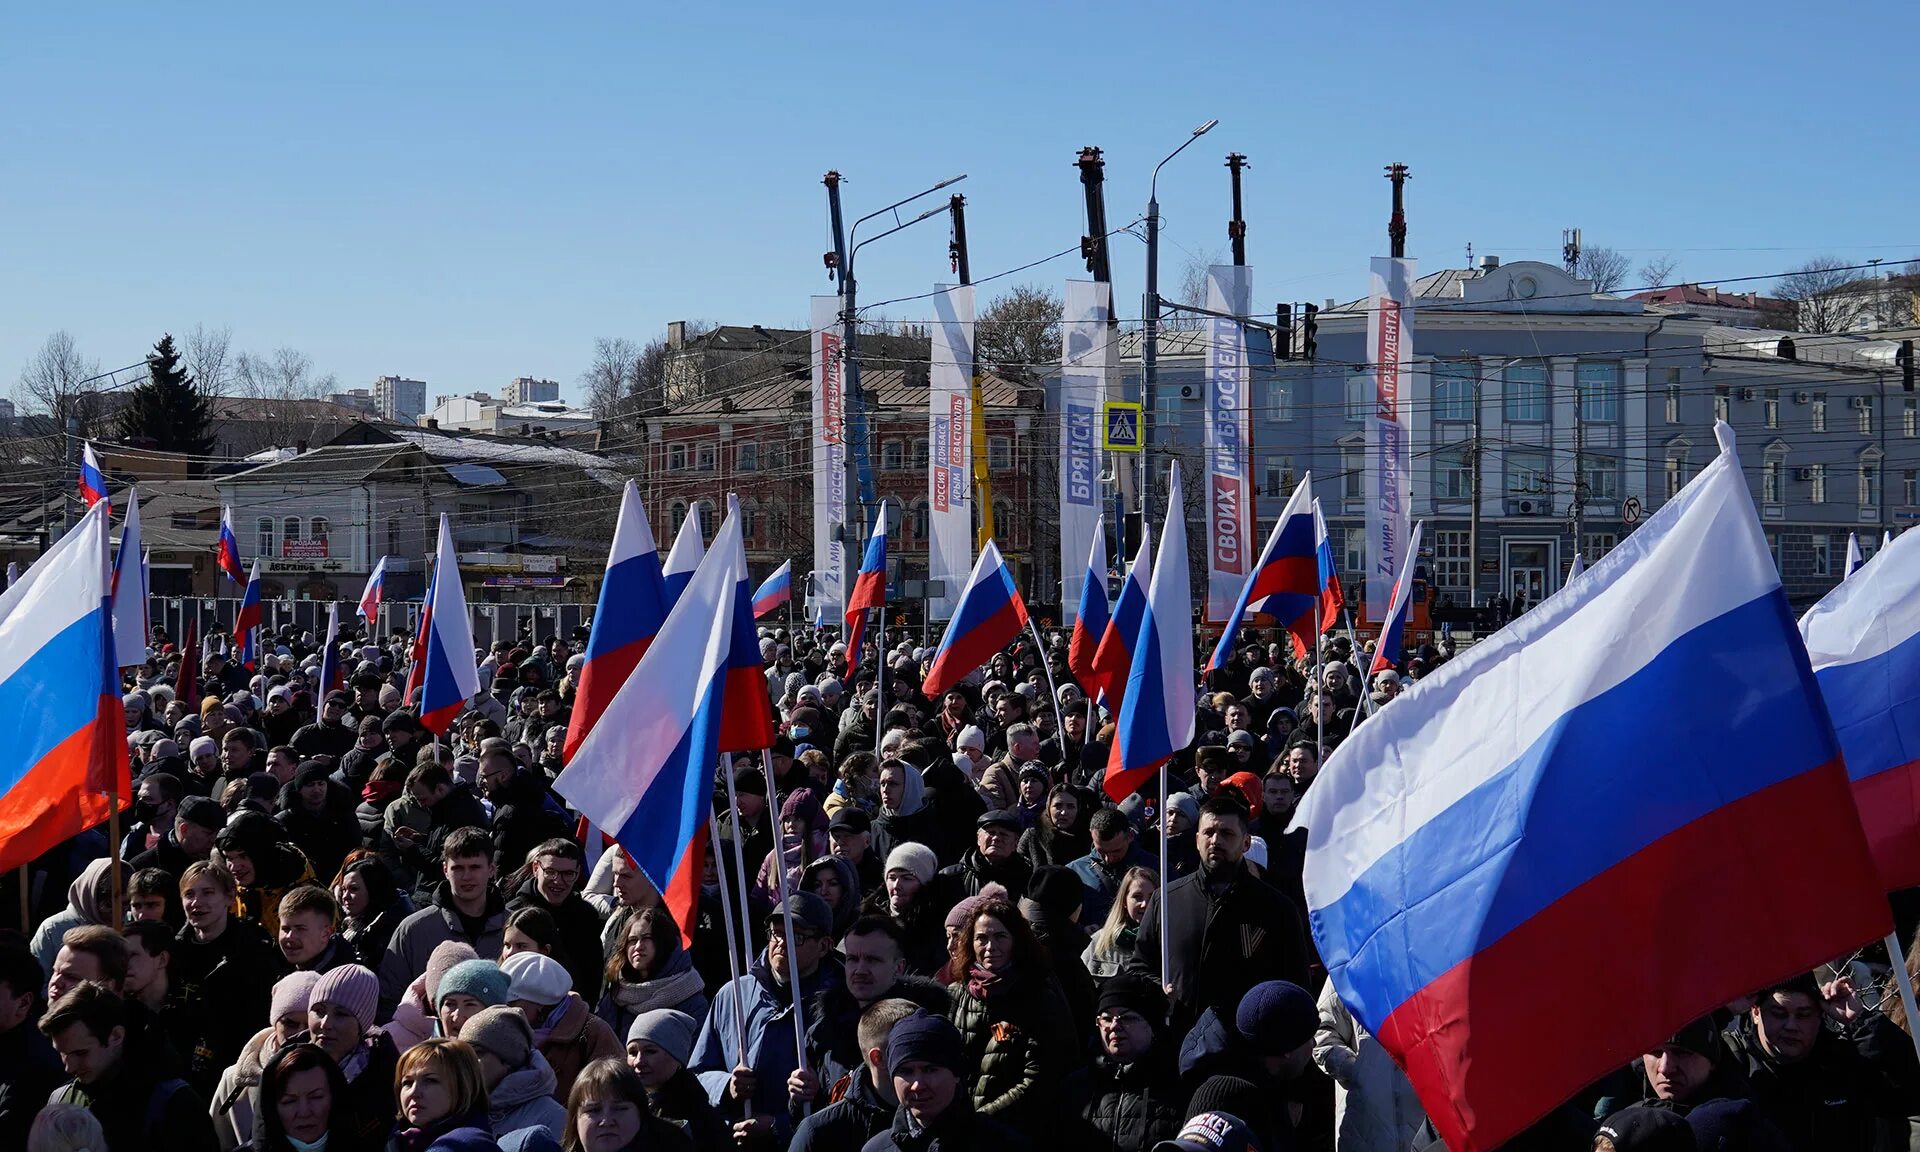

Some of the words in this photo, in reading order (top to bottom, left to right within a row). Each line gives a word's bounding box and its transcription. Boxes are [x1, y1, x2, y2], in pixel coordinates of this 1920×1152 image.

[938, 424, 947, 465] ДОНБАСС
[953, 399, 963, 463] СЕВАСТОПОЛЬ
[1072, 413, 1090, 499] БРЯНСК
[1218, 442, 1236, 471] НЕ
[937, 472, 946, 507] РОССИЯ
[952, 473, 962, 501] КРЫМ
[1217, 487, 1238, 563] СВОИХ
[830, 540, 840, 561] МИ
[1183, 1113, 1233, 1136] CKEY
